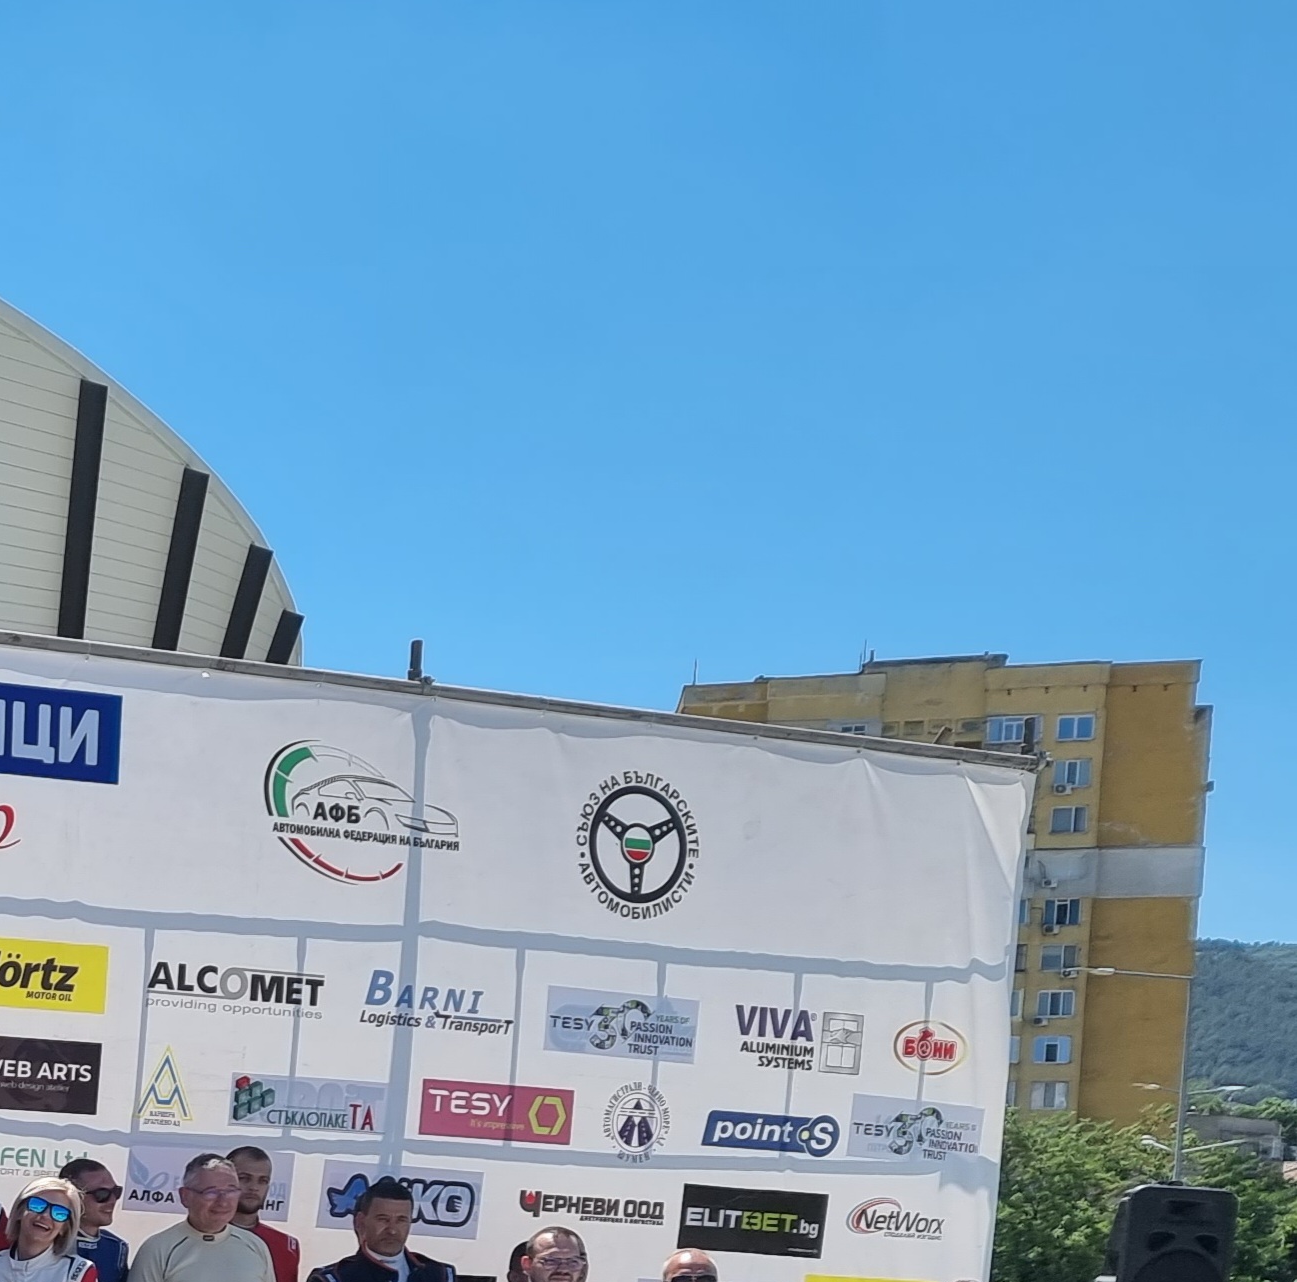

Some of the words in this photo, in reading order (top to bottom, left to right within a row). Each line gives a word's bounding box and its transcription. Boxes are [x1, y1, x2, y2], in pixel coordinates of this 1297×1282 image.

[314, 803, 361, 823] АФБ
[577, 792, 601, 846] СЪЮЗ
[599, 775, 621, 795] НА
[623, 771, 699, 858] БЪЛГАРСКИТЕ
[273, 822, 340, 838] АВТОМОБИЛНА
[343, 831, 397, 845] ФЕДЕРАЦИЯ
[399, 836, 411, 846] НА
[413, 837, 459, 851] БЪЛГАРИЯ
[578, 863, 695, 920] АВТОМОБИЛИСТИ
[148, 962, 325, 1007] ALCOMET
[364, 970, 484, 1014] BARNI
[26, 990, 57, 1001] MOTOR
[58, 992, 73, 1002] OIL
[145, 997, 217, 1013] providing
[223, 1004, 323, 1019] opportunities
[359, 1009, 421, 1029] Logistics
[425, 1015, 436, 1028] &
[550, 1015, 594, 1031] TESY
[630, 1021, 673, 1034] PASSION
[735, 1005, 813, 1041] VIVA
[627, 1044, 659, 1055] TRUST
[634, 1033, 693, 1048] INNOVATION
[741, 1041, 814, 1057] ALUMINIUM
[902, 1038, 957, 1061] БОНИ
[37, 1062, 92, 1082] ARTS
[757, 1055, 813, 1070] SYSTEMS
[429, 1089, 512, 1117] TESY
[713, 1116, 791, 1143] point
[853, 1122, 894, 1137] TESY
[926, 1127, 962, 1141] PASSION
[923, 1149, 947, 1161] TRUST
[128, 1190, 175, 1204] АЛФА
[519, 1189, 620, 1217] ЧЕРНЕВИ
[623, 1199, 664, 1220] ООД
[856, 1208, 945, 1234] NetWorx
